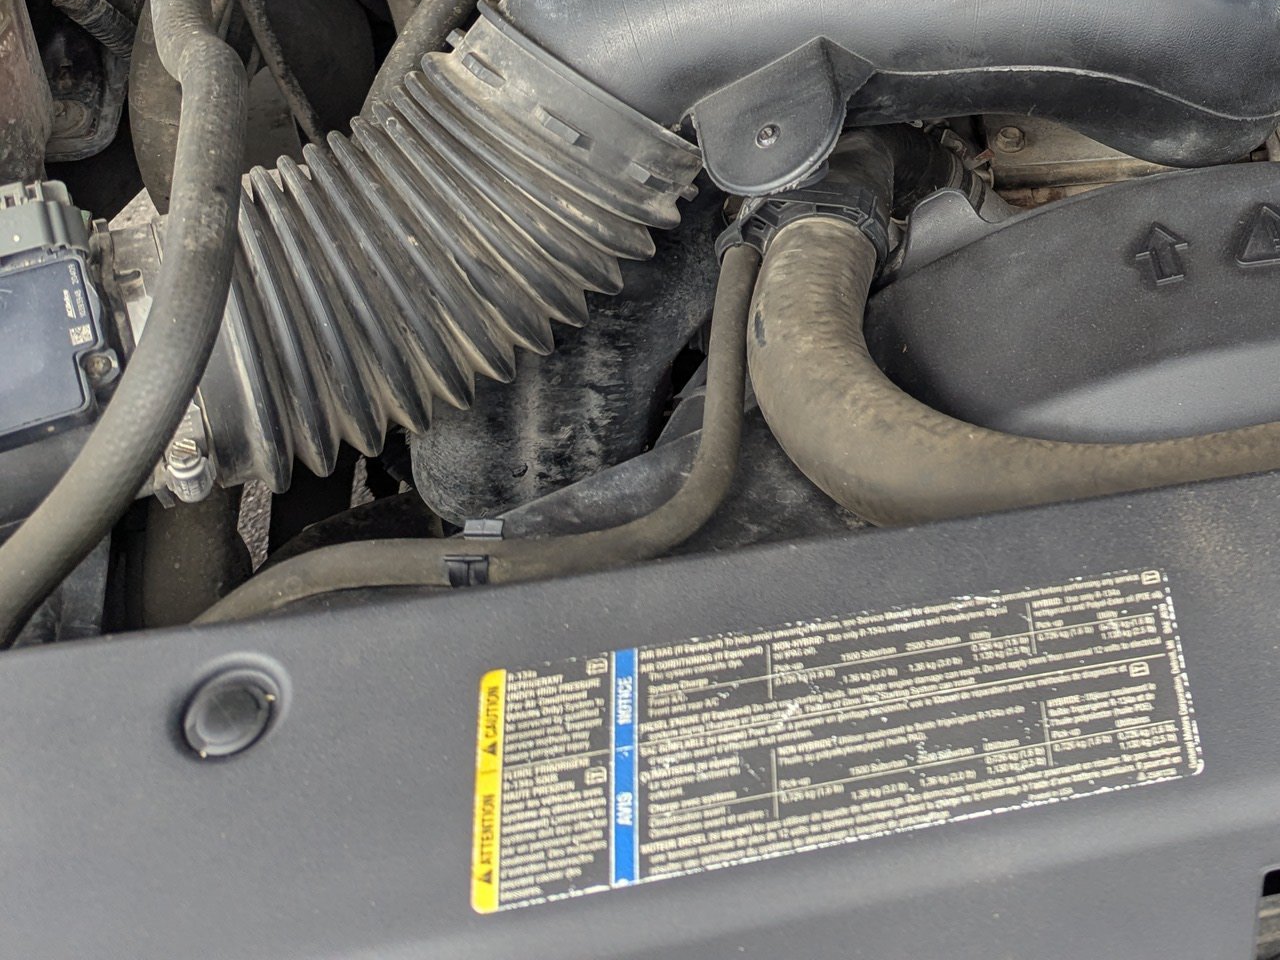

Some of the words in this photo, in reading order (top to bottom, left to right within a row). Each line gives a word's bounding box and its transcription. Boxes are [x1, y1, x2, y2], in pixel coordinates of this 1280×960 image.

[484, 685, 500, 738] CAUTION
[616, 675, 632, 726] NOTICE
[479, 792, 495, 866] ATTENTION
[616, 790, 633, 828] AVIS
